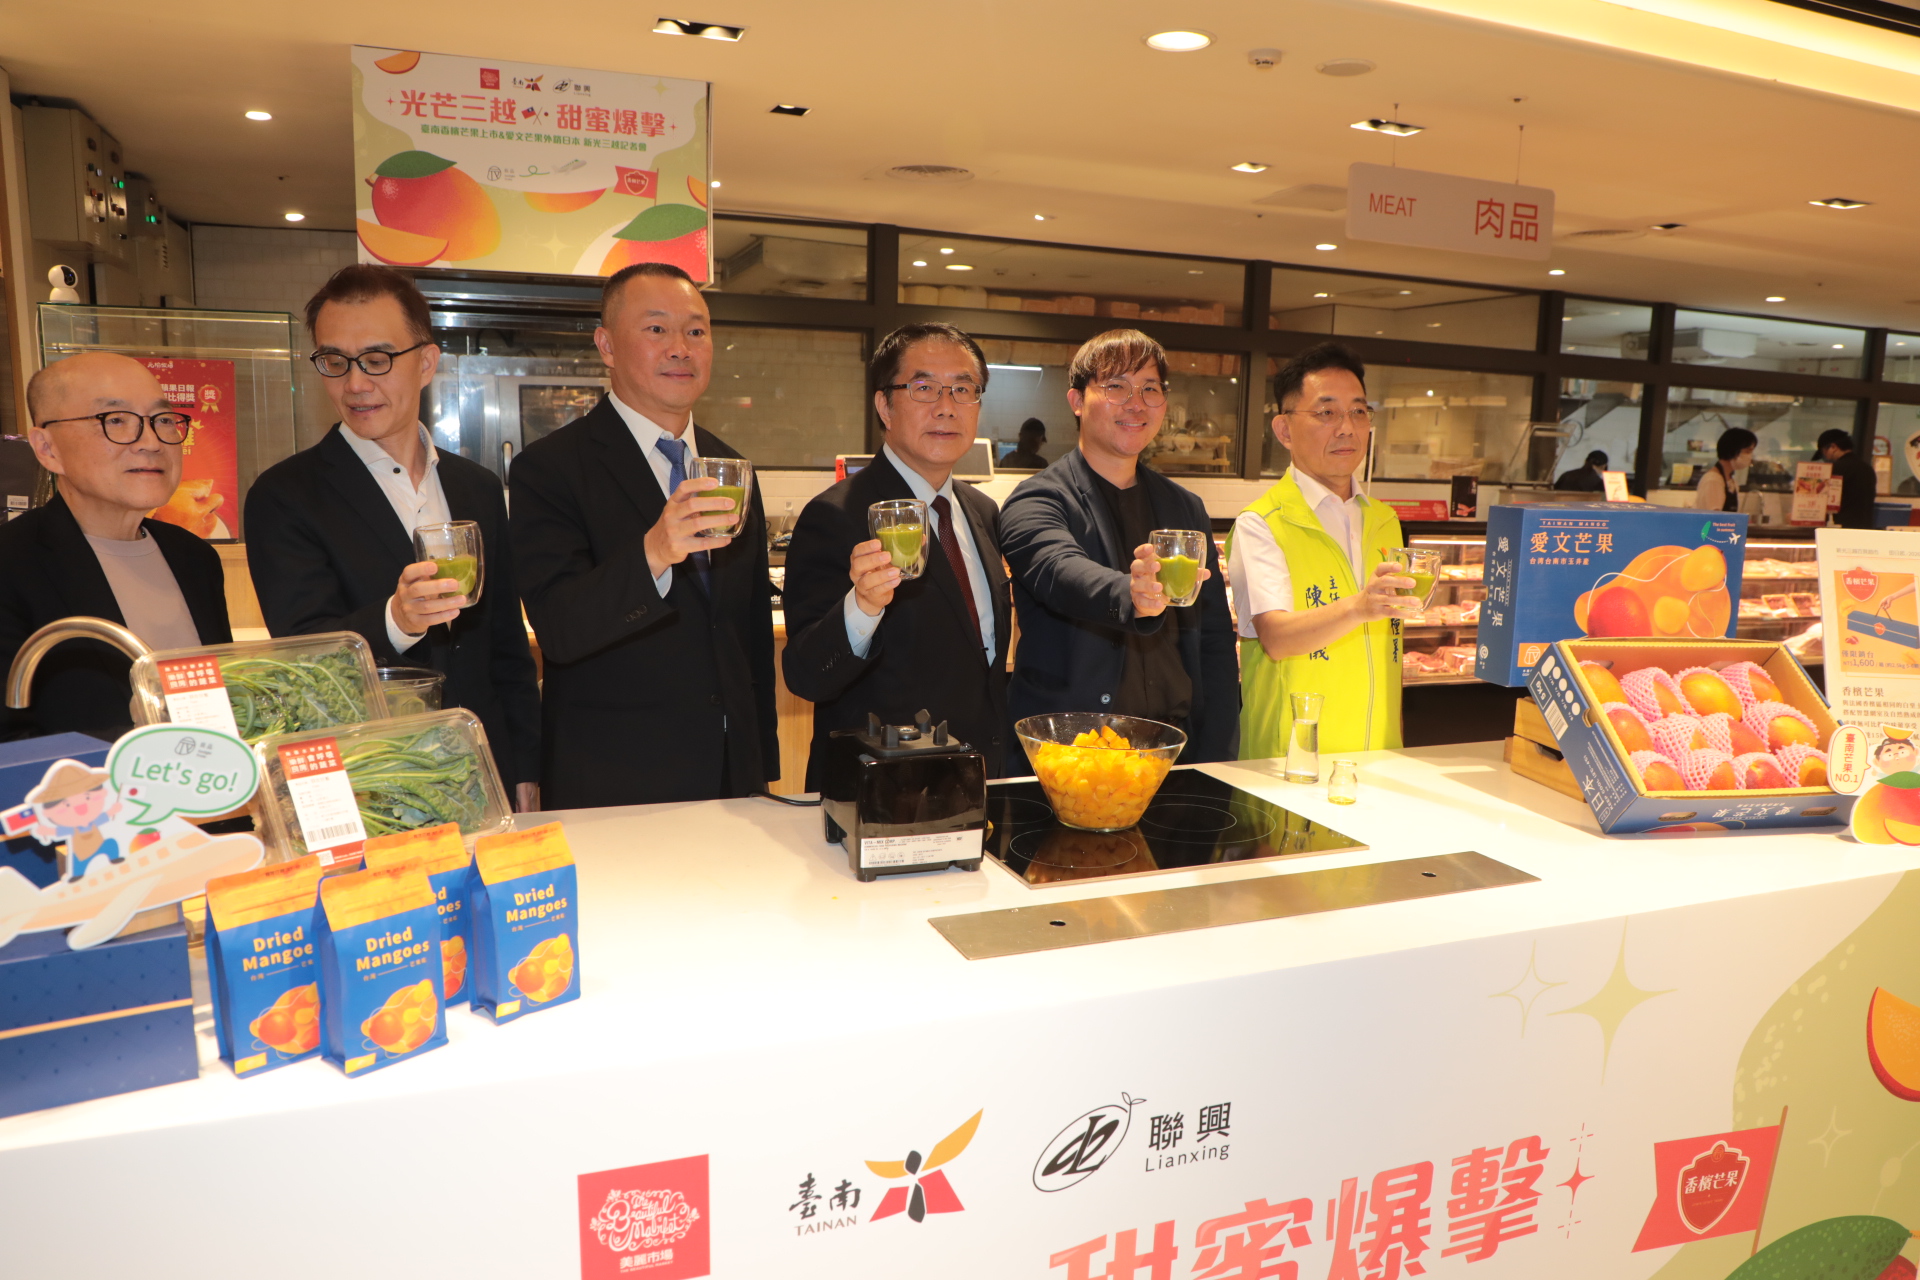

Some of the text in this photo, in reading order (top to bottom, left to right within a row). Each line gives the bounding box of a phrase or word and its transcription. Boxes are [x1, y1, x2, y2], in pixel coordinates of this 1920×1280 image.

[400, 89, 666, 138] 光芒三越 甜蜜爆擊
[1369, 193, 1416, 218] MEAT
[1475, 198, 1539, 243] 肉品
[1530, 532, 1613, 554] 愛文芒果
[1492, 536, 1509, 627] 愛文芒果
[1845, 577, 1875, 586] 香檳芒果
[1842, 686, 1884, 697] 香檳芒果
[1842, 733, 1856, 773] 臺南芒果
[131, 756, 238, 795] Let's go!
[1835, 773, 1859, 783] NO.1
[1582, 774, 1605, 812] 日本
[514, 884, 555, 906] Dried
[506, 898, 568, 923] Mangoes
[253, 926, 304, 953] Dried
[365, 926, 413, 953] Dried
[242, 943, 313, 972] Mangoe
[356, 940, 430, 972] Mangoes
[1149, 1101, 1231, 1151] 聯興
[1145, 1144, 1230, 1172] Lianxing
[1684, 1169, 1739, 1194] 香檳芒果
[789, 1172, 861, 1220] 臺南
[794, 1215, 857, 1236] TAINAN
[620, 1248, 673, 1269] 美麗市場
